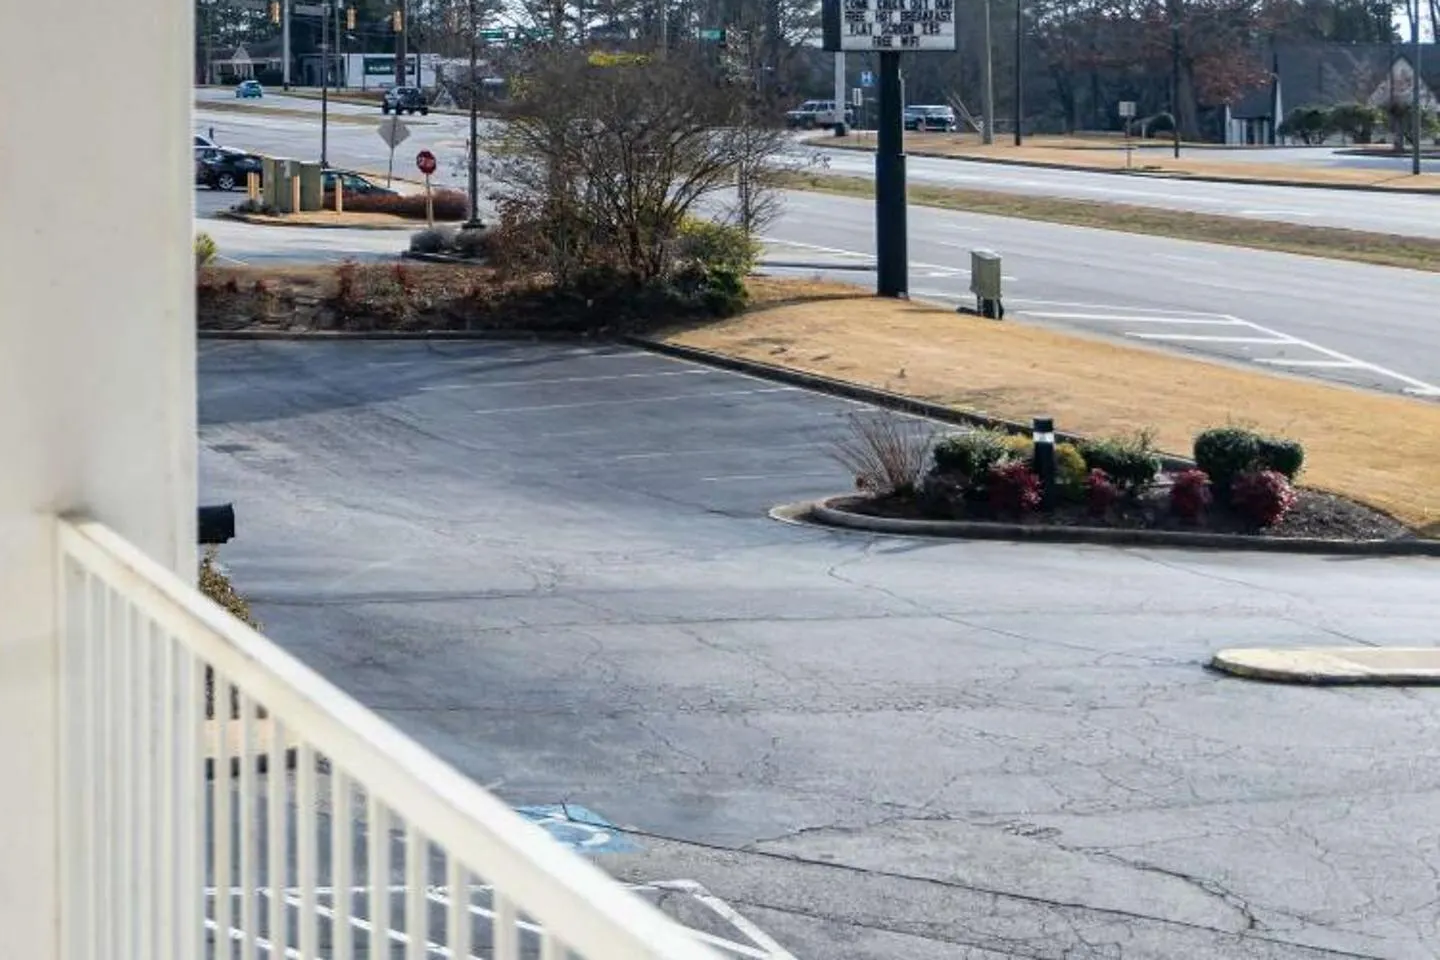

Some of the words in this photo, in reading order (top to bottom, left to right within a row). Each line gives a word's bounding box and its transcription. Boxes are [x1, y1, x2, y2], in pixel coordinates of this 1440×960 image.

[845, 10, 865, 22] FREE
[875, 10, 893, 22] HOT
[901, 10, 952, 22] BREAKFAST
[873, 35, 892, 48] FREE
